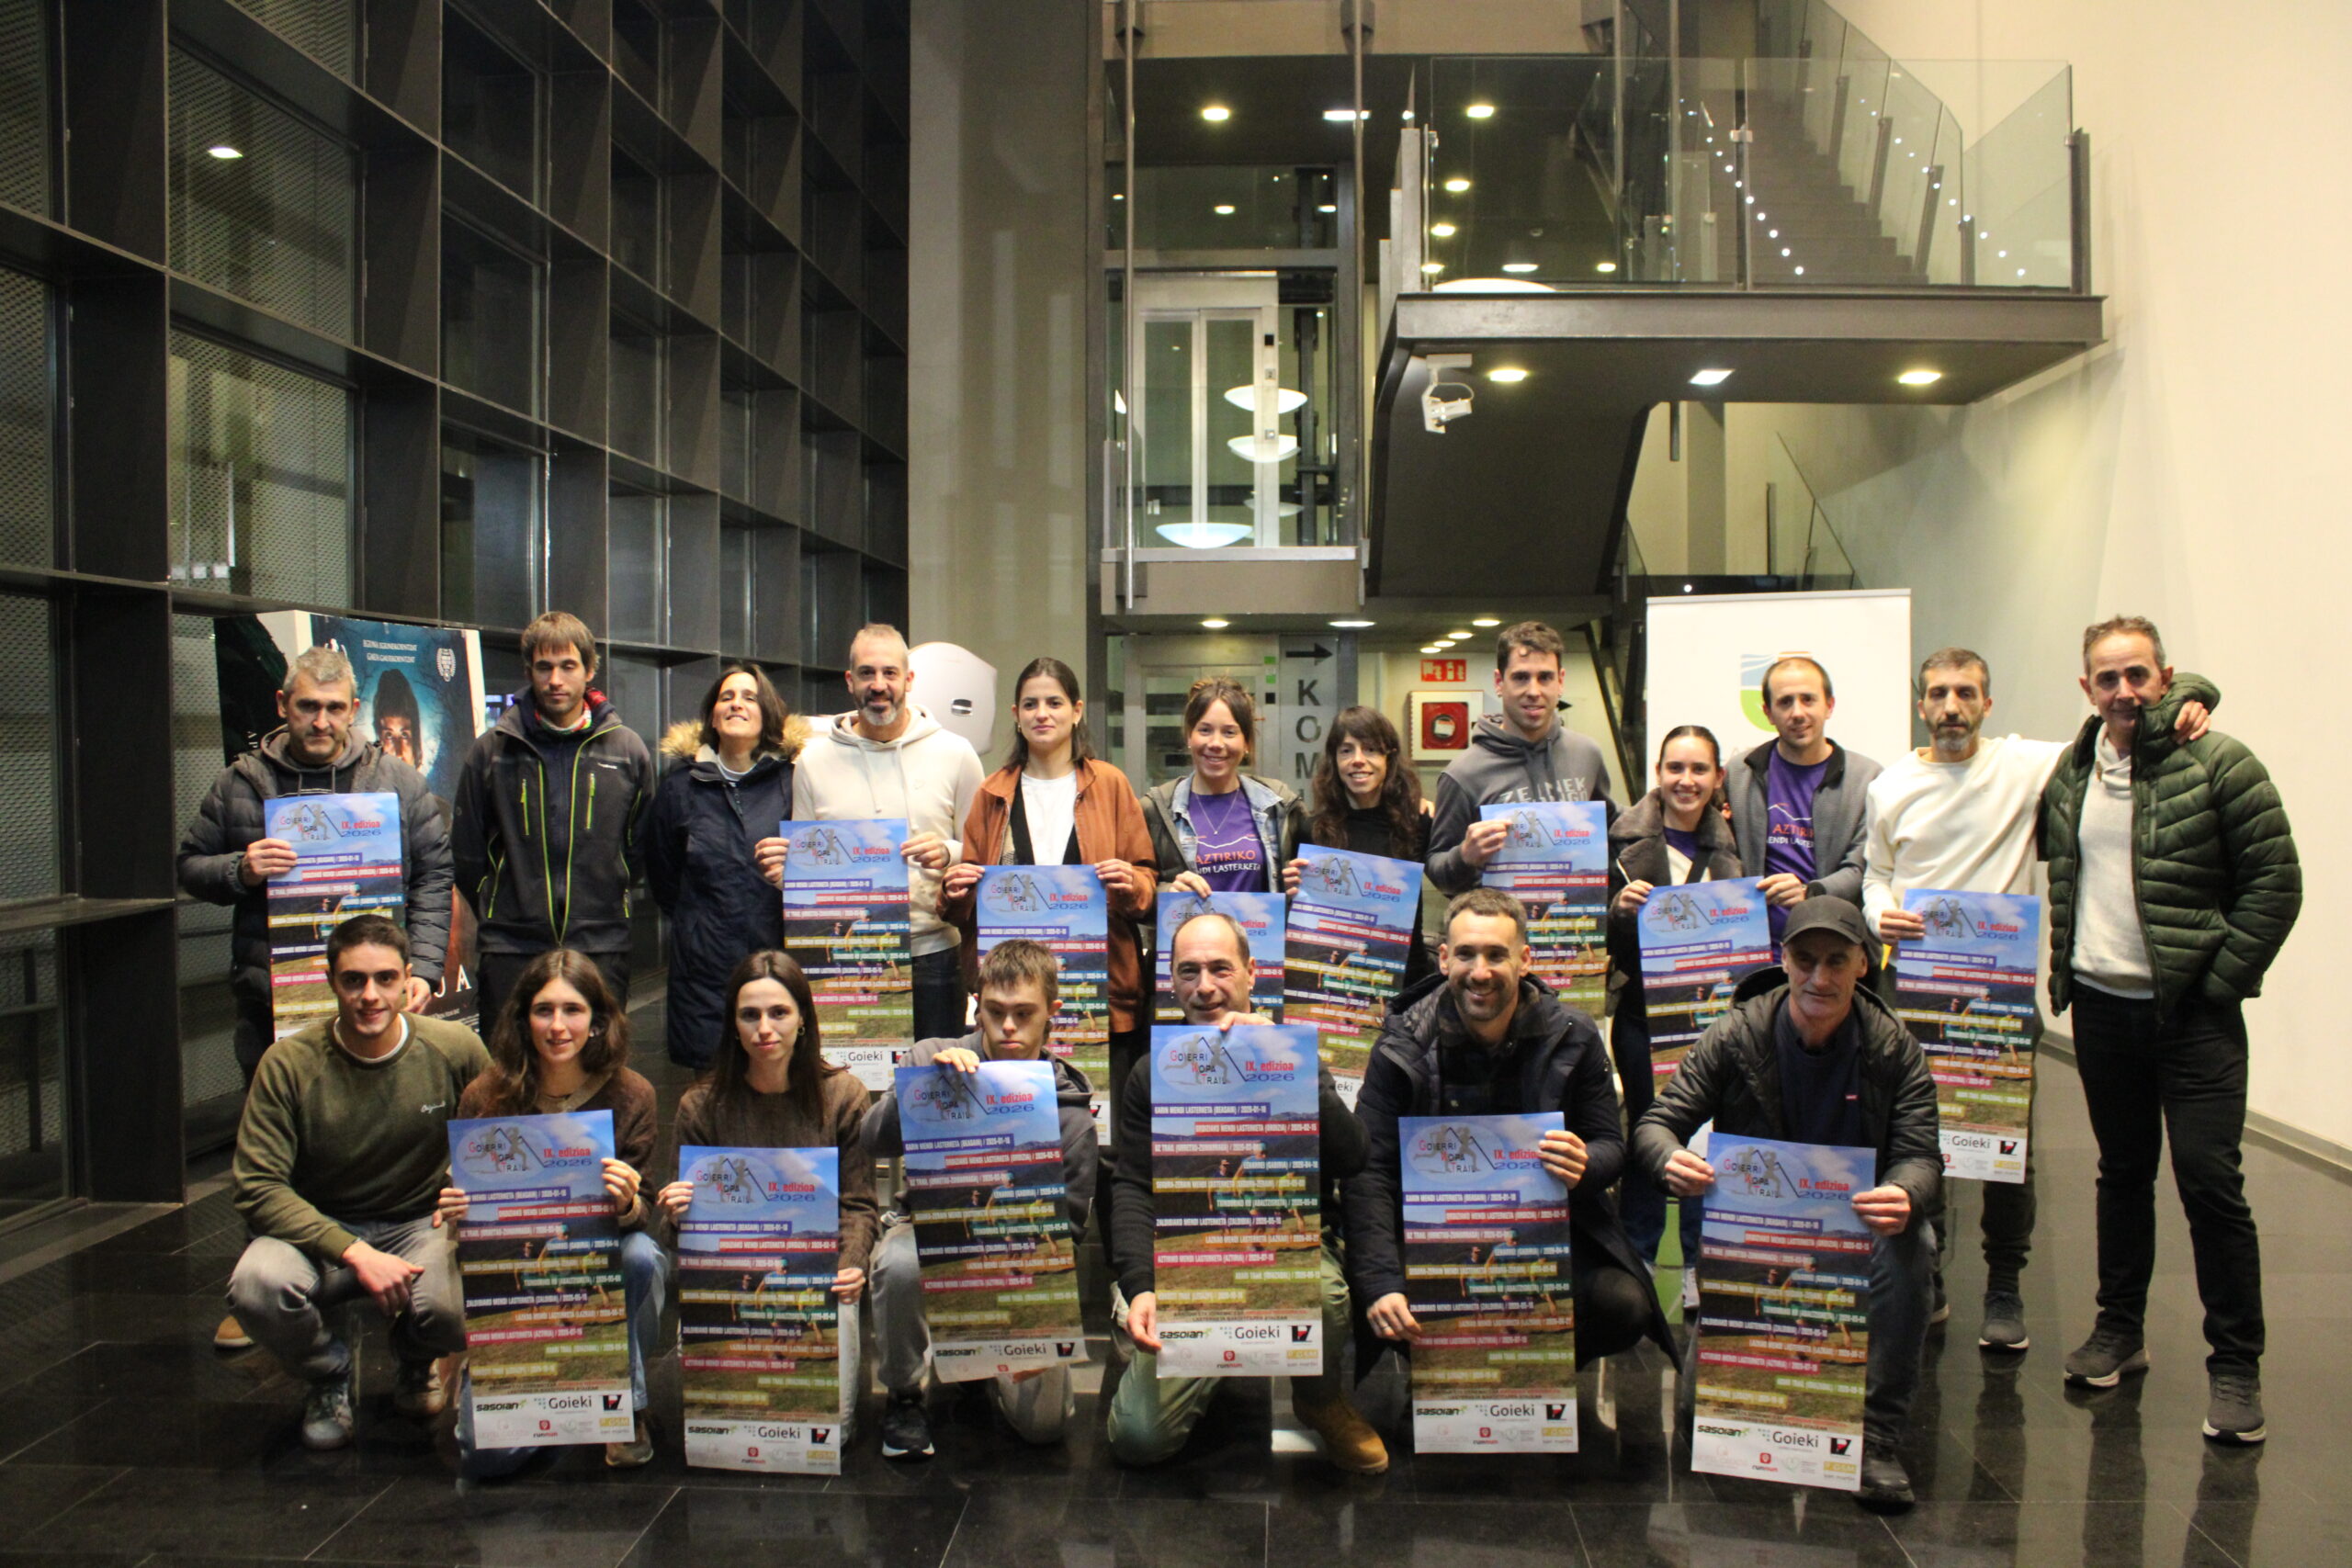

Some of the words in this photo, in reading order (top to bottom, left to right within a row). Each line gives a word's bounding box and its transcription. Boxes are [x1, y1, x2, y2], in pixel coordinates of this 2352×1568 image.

[342, 829, 380, 837] 2026
[1195, 850, 1256, 864] AZTIRIKO
[1363, 889, 1400, 902] 2026
[1978, 931, 2018, 941] 2026
[848, 1050, 882, 1061] Goieki
[1260, 1060, 1294, 1071] edizioa
[1246, 1073, 1295, 1081] 2026
[999, 1090, 1032, 1103] edizioa
[987, 1103, 1034, 1114] 2026
[1951, 1134, 1990, 1149] Goieki
[557, 1145, 590, 1157] edizioa
[544, 1157, 592, 1168] 2026
[781, 1181, 814, 1191] edizioa
[1814, 1179, 1849, 1191] edizioa
[767, 1193, 814, 1201] 2026
[1800, 1190, 1849, 1201] 2026
[1234, 1325, 1280, 1338] Goieki
[1002, 1342, 1046, 1356] Goieki
[548, 1394, 592, 1409] Goieki
[1490, 1404, 1534, 1416] Goieki
[757, 1425, 799, 1439] Goieki
[1772, 1428, 1818, 1448] Goieki
